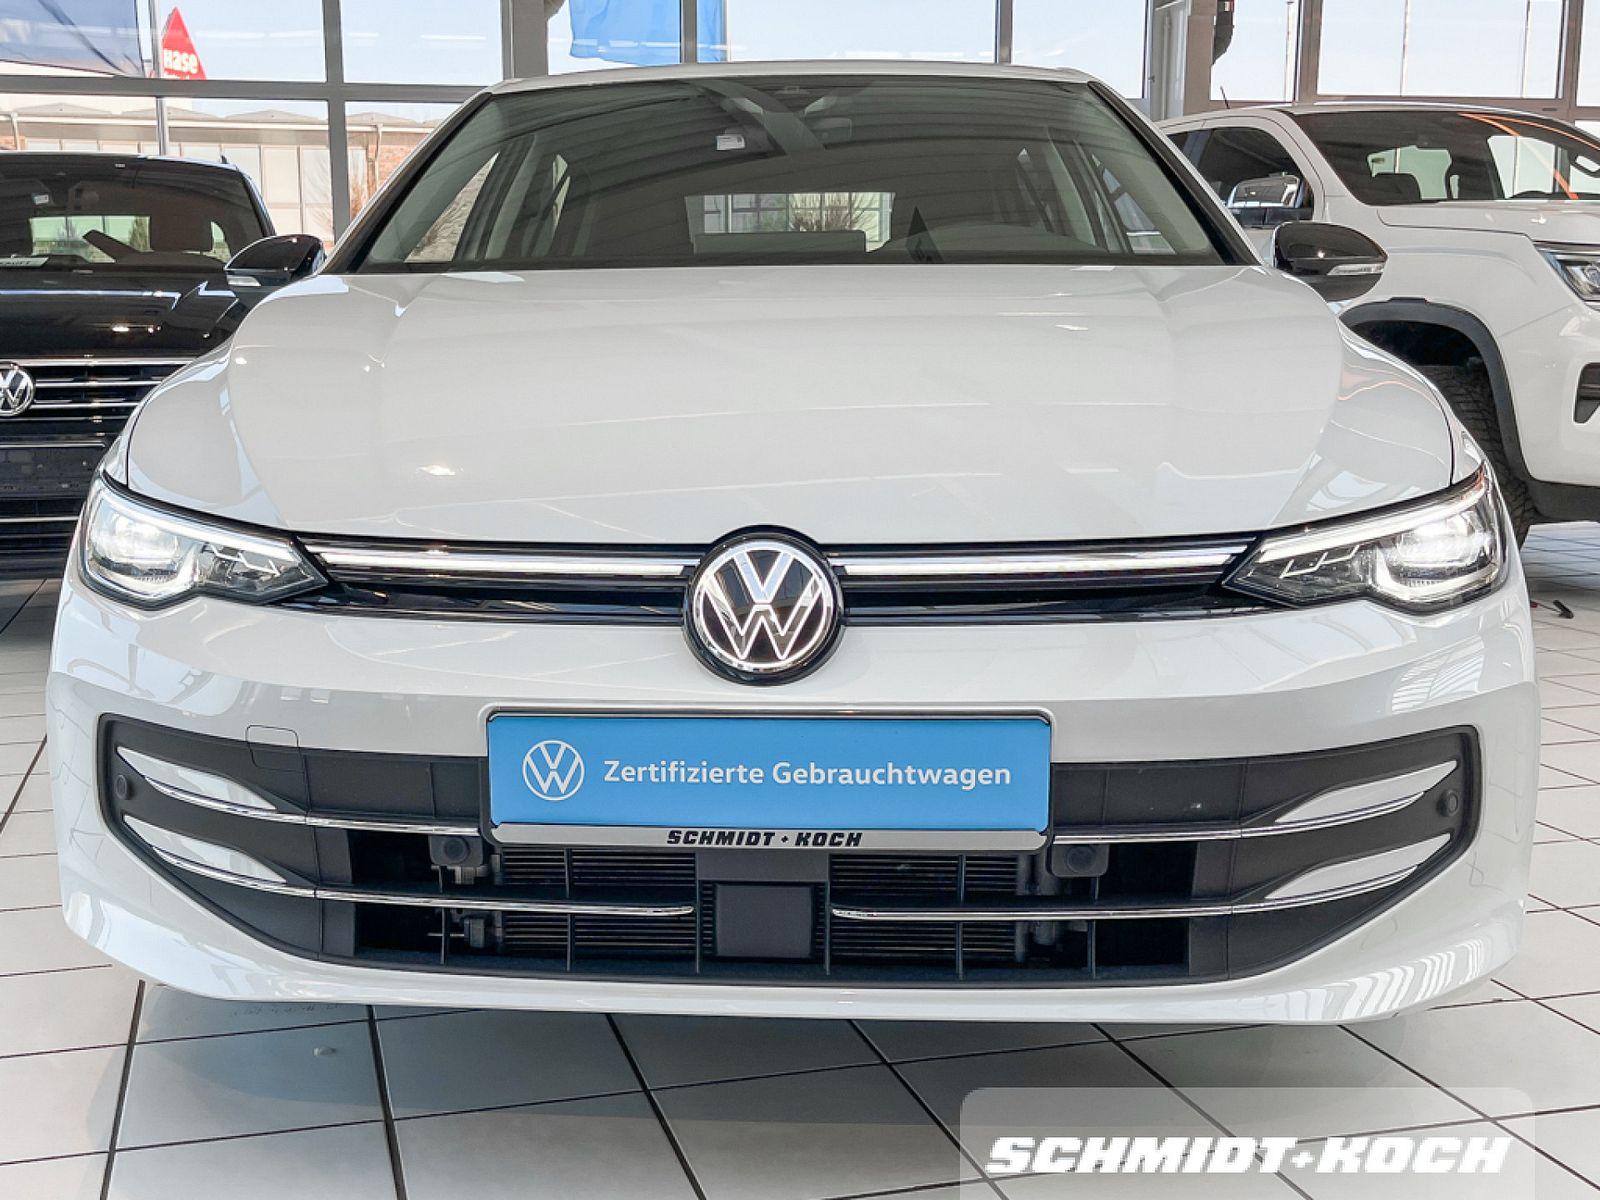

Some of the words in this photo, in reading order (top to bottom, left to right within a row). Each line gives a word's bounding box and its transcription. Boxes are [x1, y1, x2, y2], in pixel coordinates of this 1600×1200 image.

[603, 760, 764, 785] Zertifizierte
[772, 762, 1012, 791] Gebrauchtwagen
[667, 830, 775, 846] SCHMIDT
[795, 832, 863, 847] KOCH
